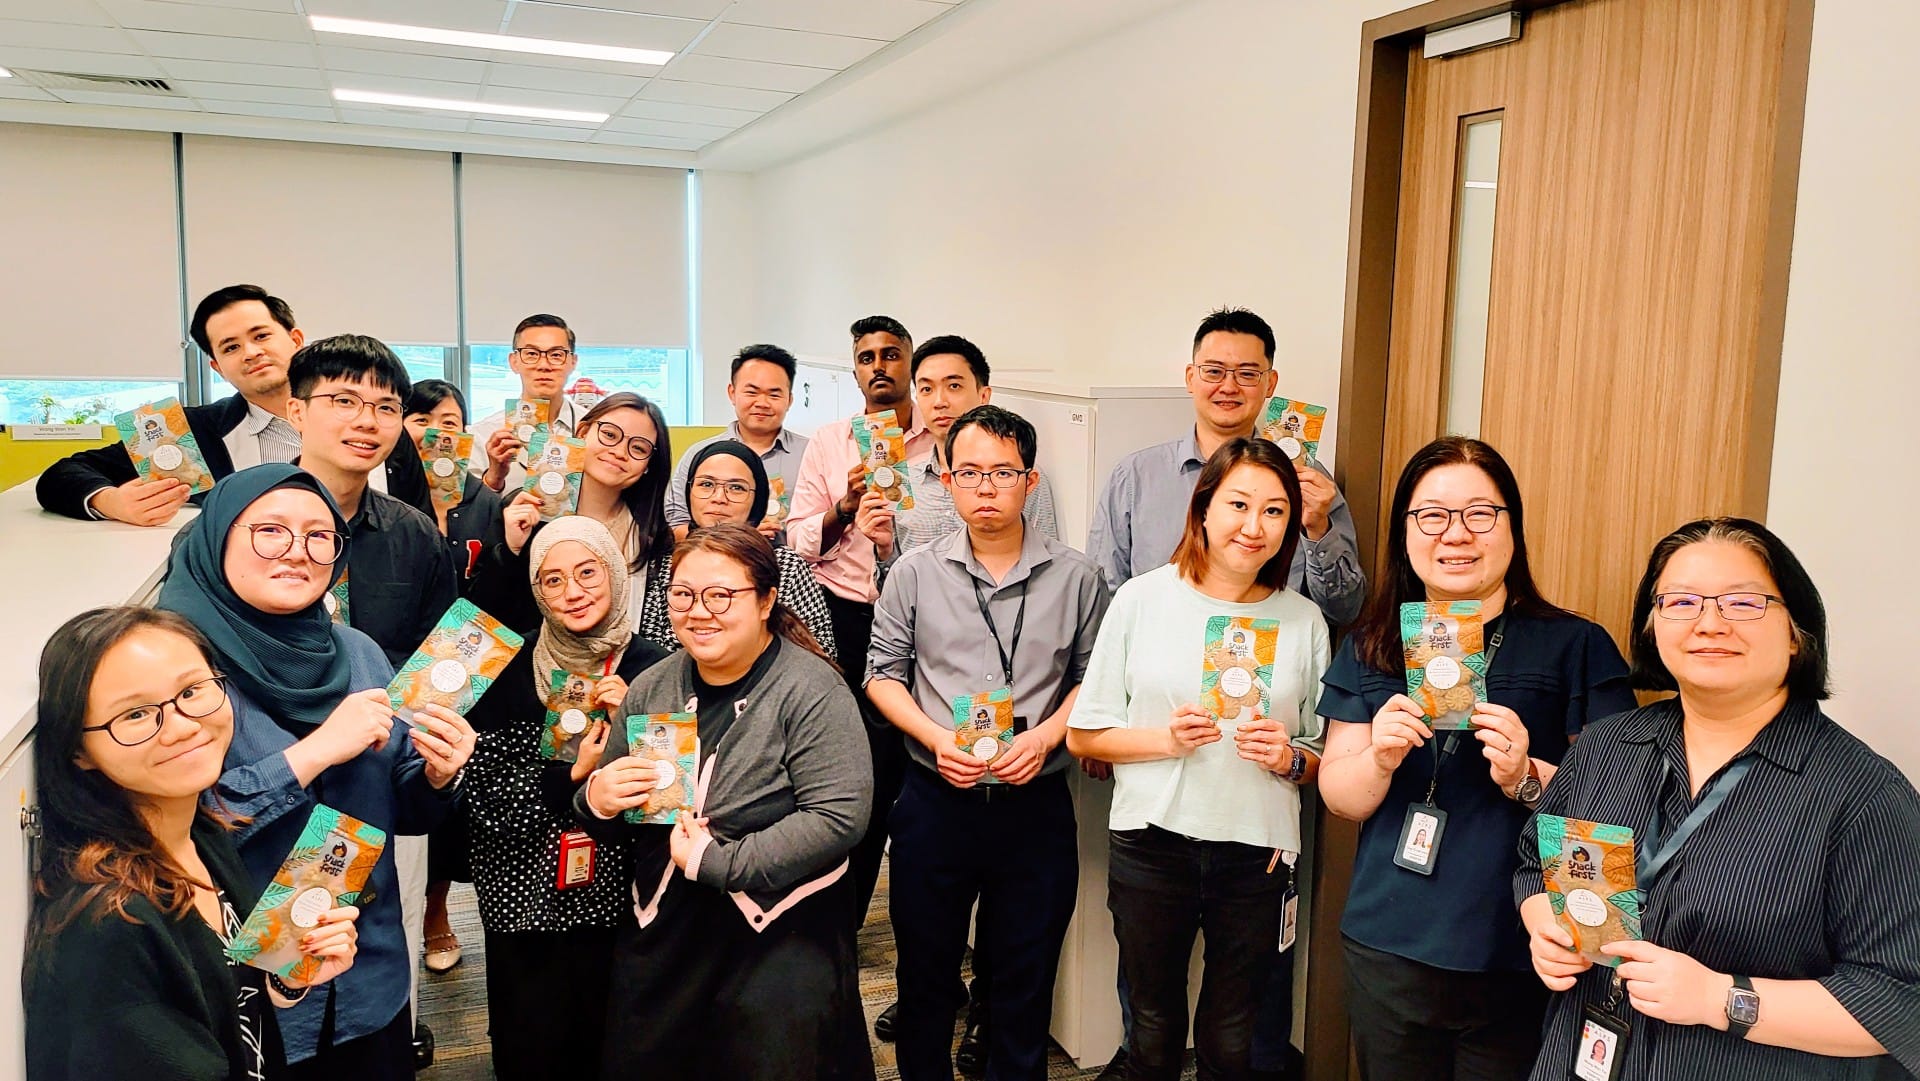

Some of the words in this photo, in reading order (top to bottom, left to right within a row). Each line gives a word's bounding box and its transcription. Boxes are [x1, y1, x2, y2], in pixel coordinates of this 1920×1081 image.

[1429, 641, 1452, 650] first
[975, 717, 991, 726] snack
[975, 723, 991, 731] first
[323, 853, 347, 868] snack
[1568, 860, 1597, 871] snack
[319, 864, 343, 877] first
[1568, 869, 1597, 880] first
